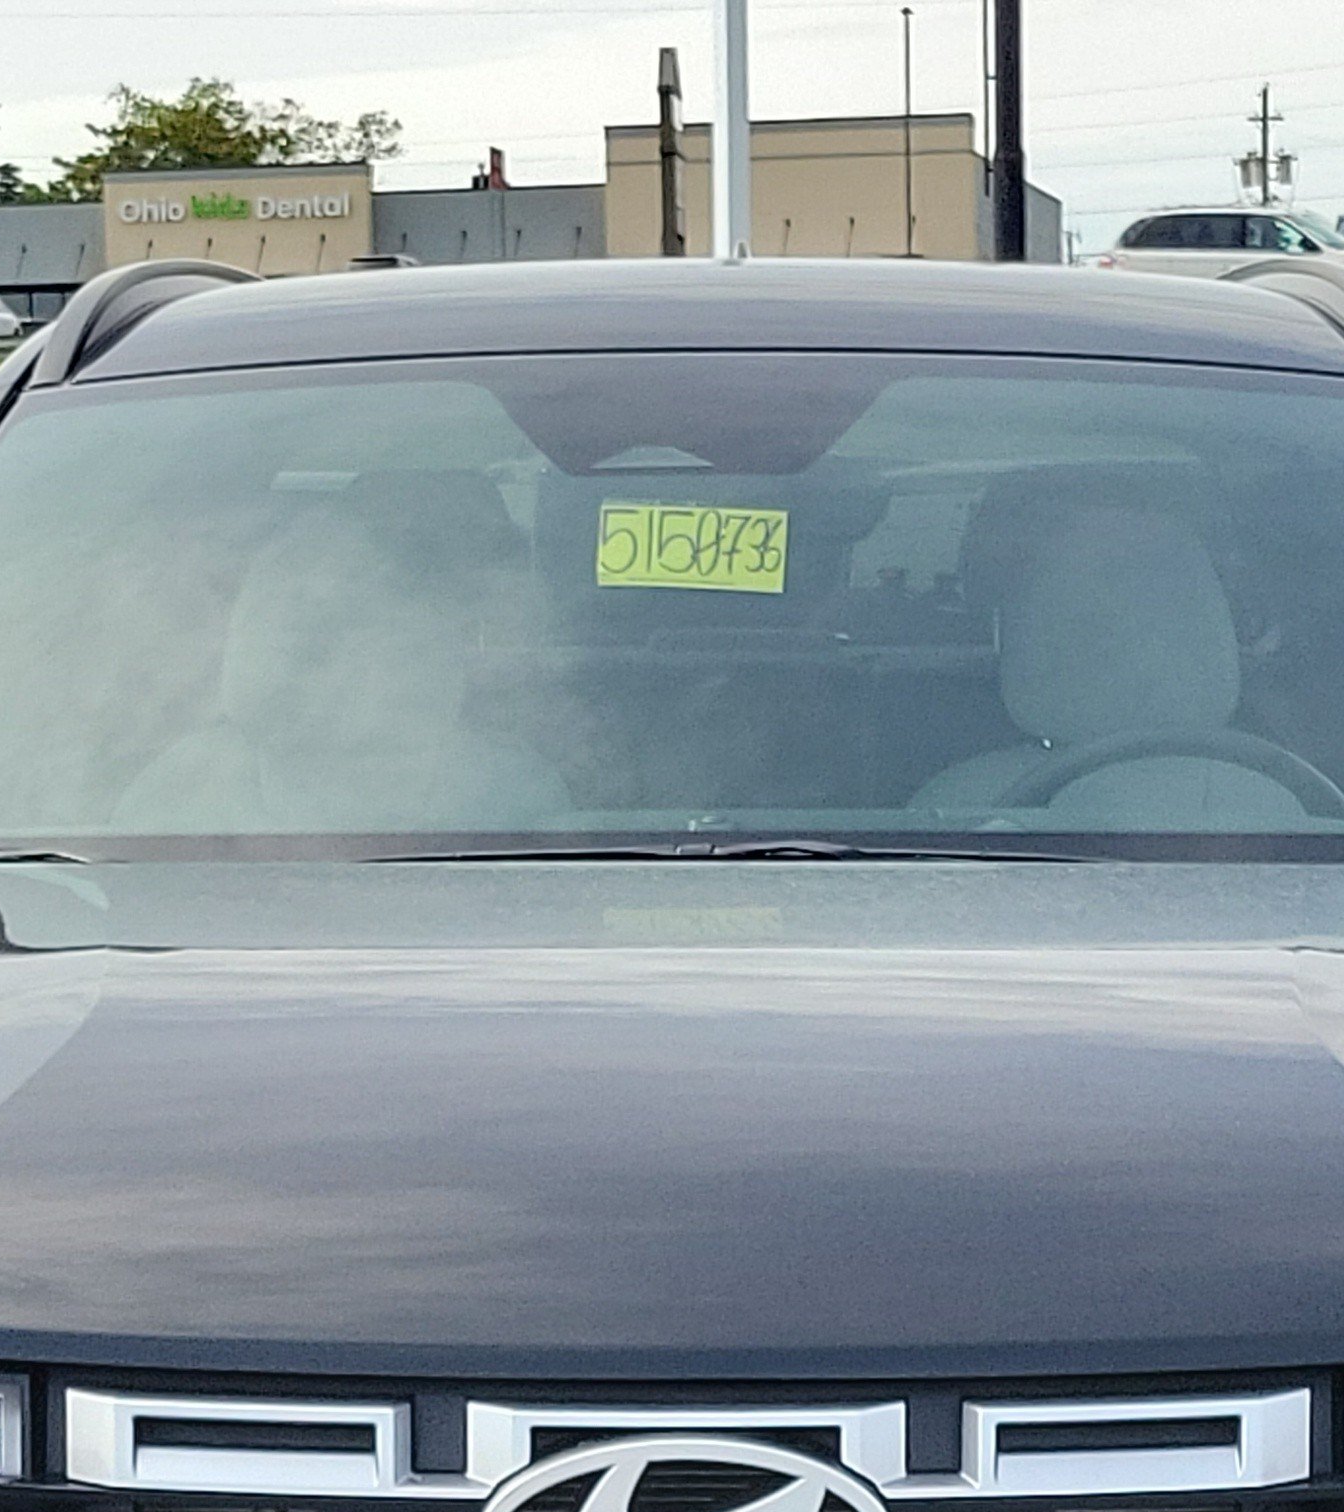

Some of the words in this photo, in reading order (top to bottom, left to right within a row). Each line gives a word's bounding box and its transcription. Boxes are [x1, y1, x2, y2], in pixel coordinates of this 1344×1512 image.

[119, 196, 186, 223] Ohio
[255, 192, 352, 221] Dental
[601, 510, 782, 576] 5150736
